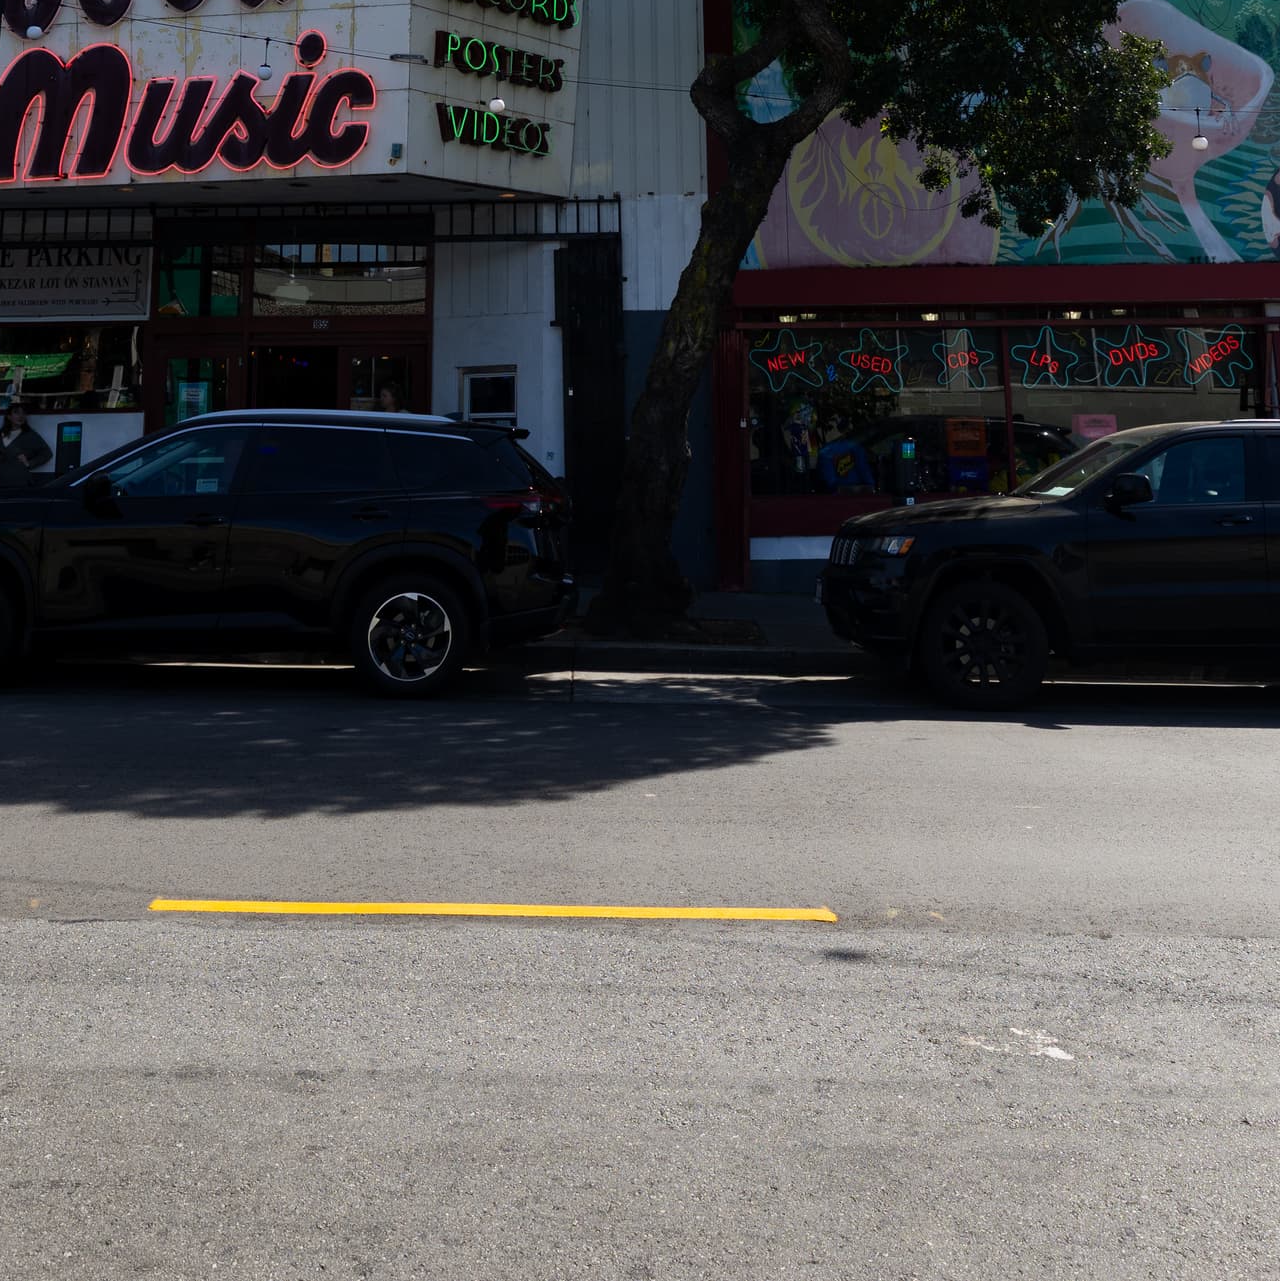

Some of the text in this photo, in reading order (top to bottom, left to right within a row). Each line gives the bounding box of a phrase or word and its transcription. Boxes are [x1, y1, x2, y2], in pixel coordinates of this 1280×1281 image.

[434, 30, 567, 92] POSTERS
[436, 102, 553, 157] VIDEOS
[25, 245, 143, 268] PARKING
[0, 278, 36, 290] KEZAR
[40, 277, 60, 289] LOT
[64, 277, 79, 289] ON
[82, 275, 130, 289] STANYAN
[767, 350, 807, 373] NEW
[849, 352, 893, 375] USED
[1188, 334, 1241, 375] VIDEOS
